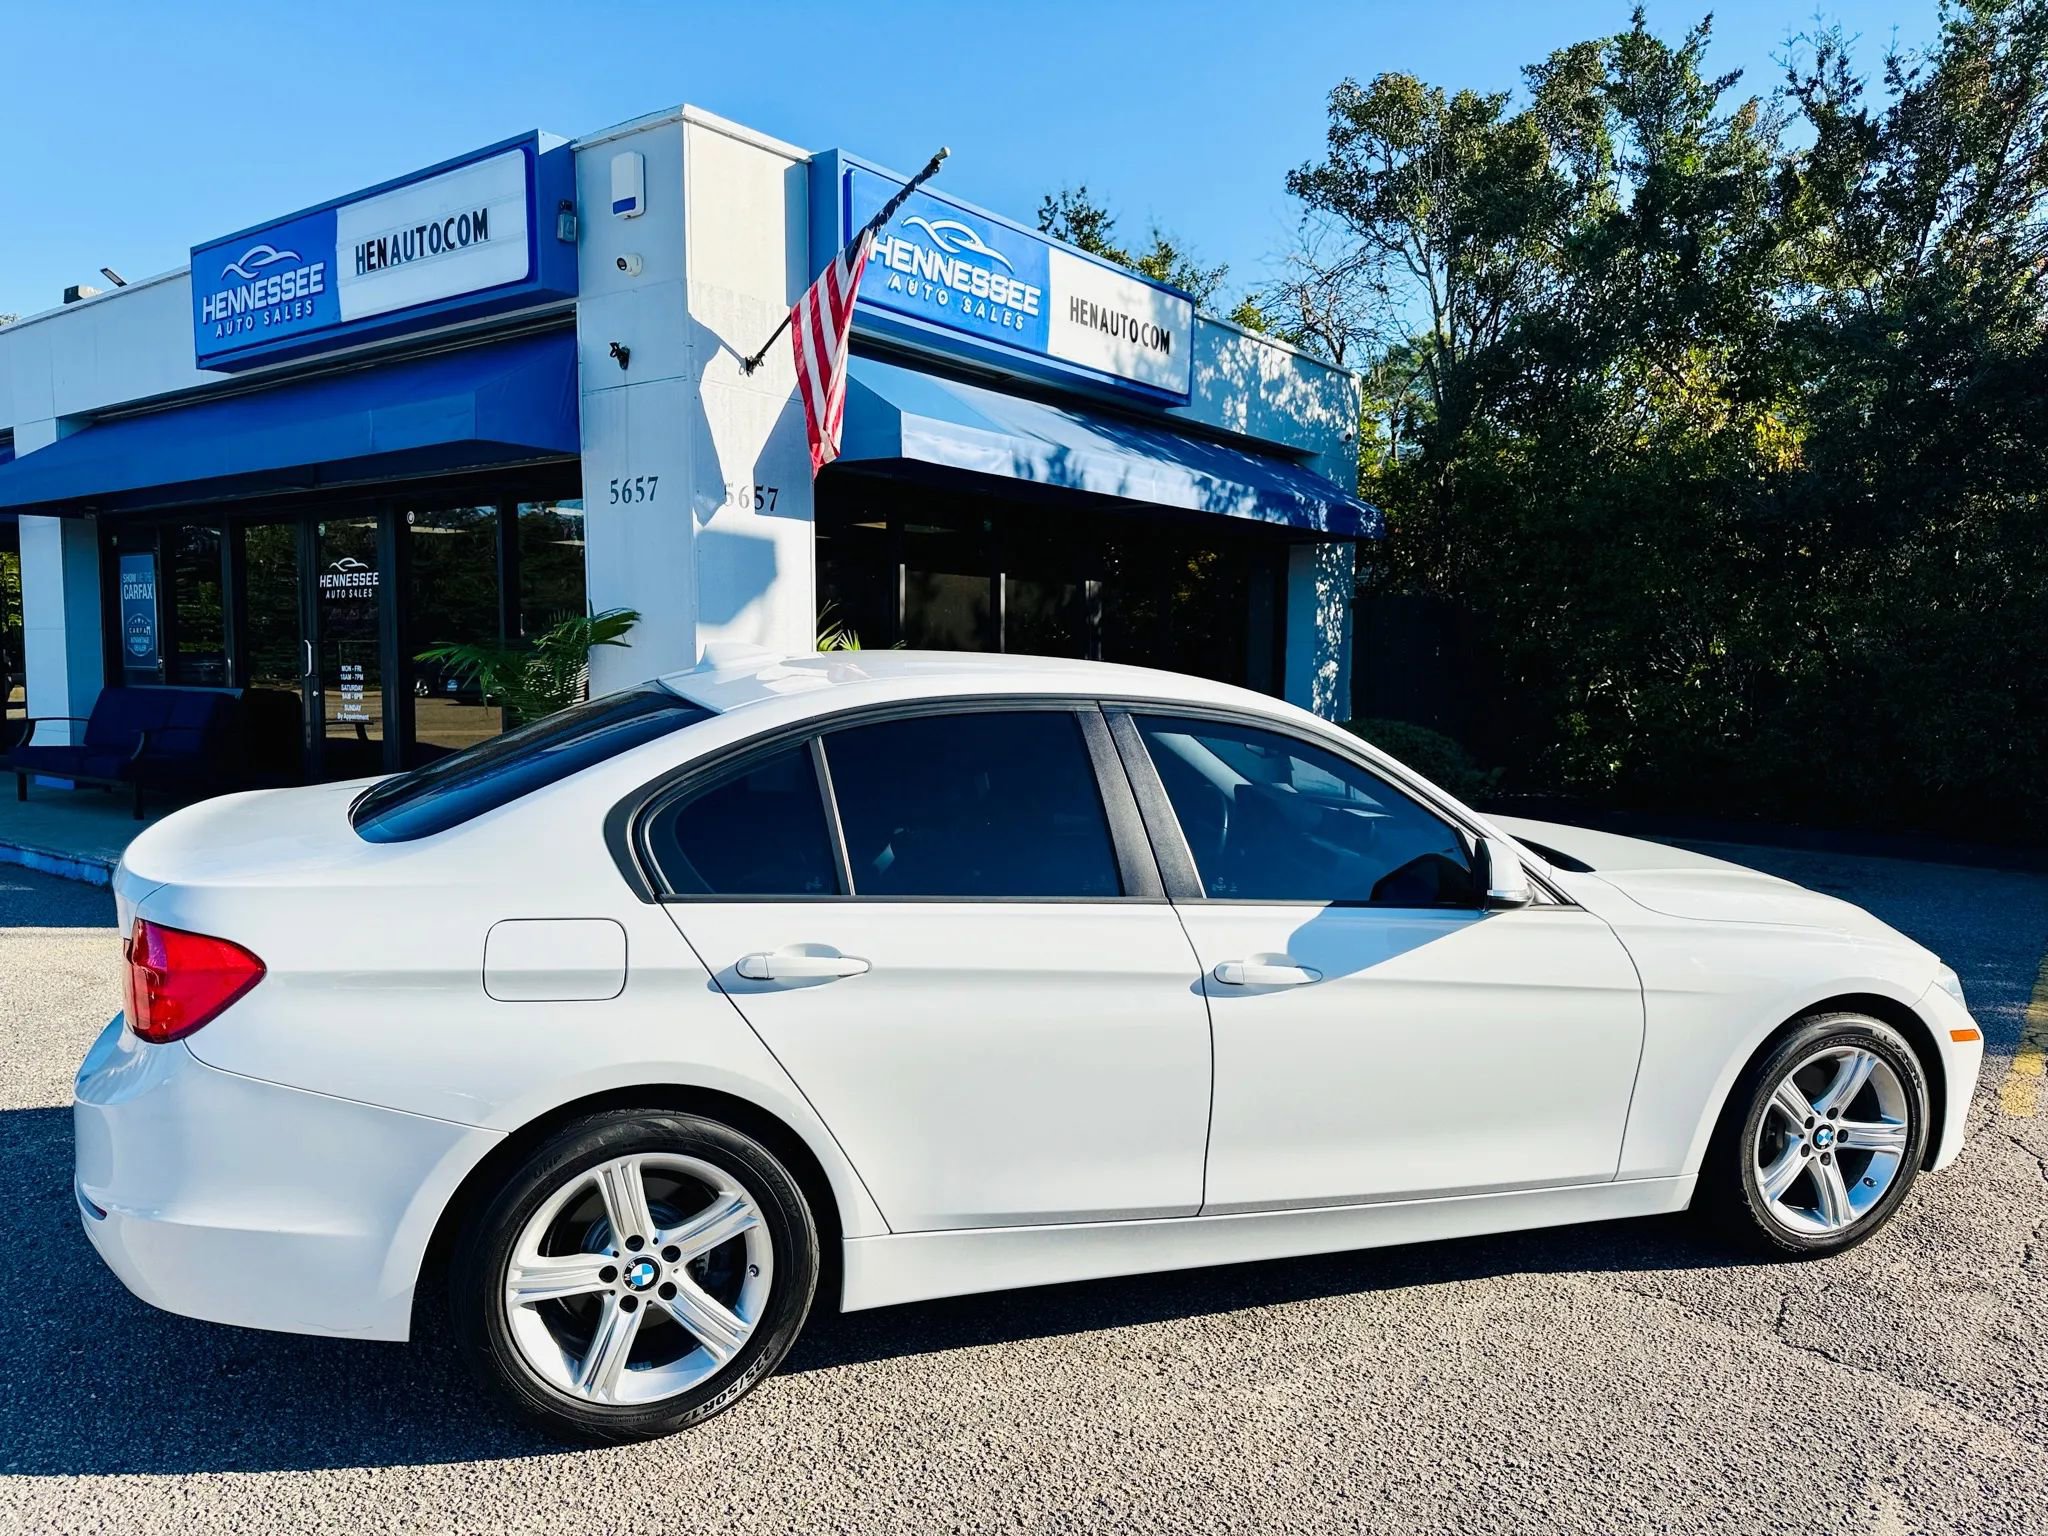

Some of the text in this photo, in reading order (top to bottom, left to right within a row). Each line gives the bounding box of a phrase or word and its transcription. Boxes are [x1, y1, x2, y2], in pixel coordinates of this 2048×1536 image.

[355, 207, 489, 275] HENAUTO.COM
[202, 262, 325, 324] HENNESSEE
[868, 233, 1042, 317] HENNESSEE
[215, 299, 313, 338] AUTO SALES
[888, 272, 1025, 331] AUTO SALES
[610, 476, 658, 504] 5657
[724, 484, 779, 511] 5657
[123, 583, 153, 600] CARFAX
[320, 572, 380, 588] HENNESSEE
[326, 588, 373, 599] AUTO SALES
[677, 1346, 773, 1426] 225/50R17
